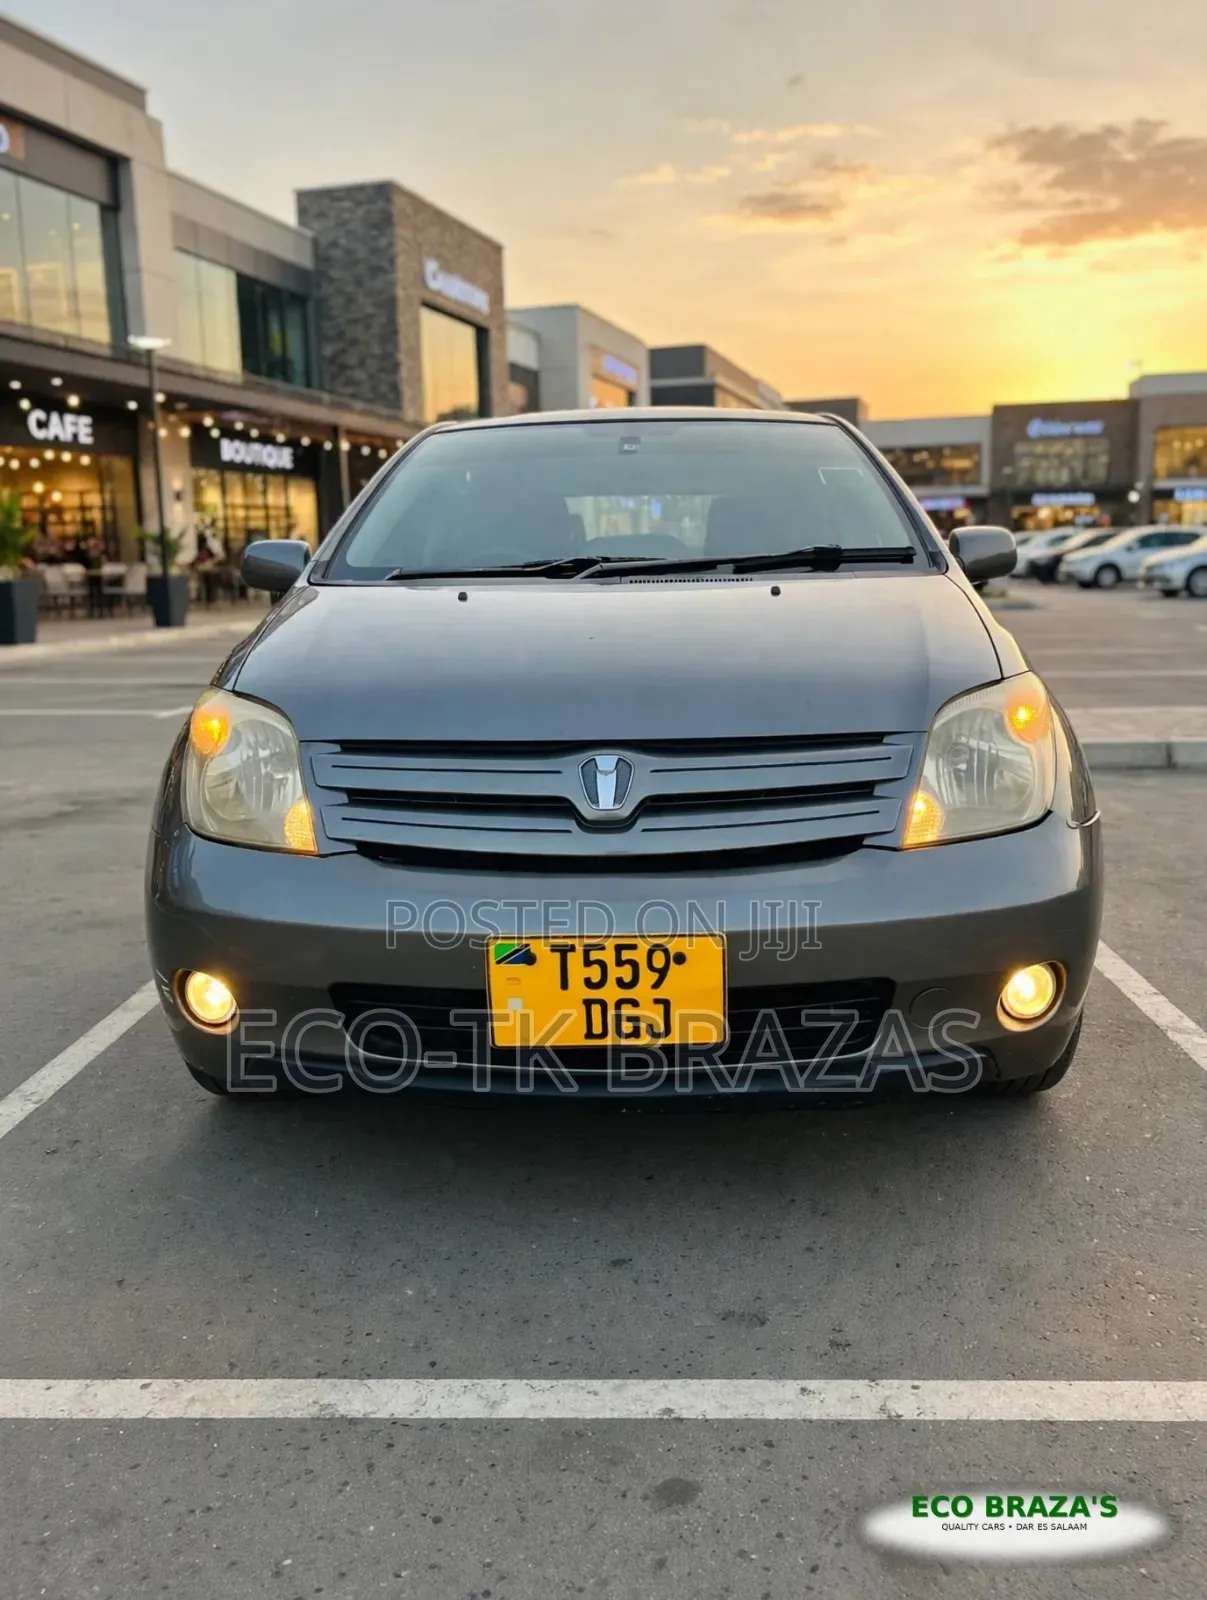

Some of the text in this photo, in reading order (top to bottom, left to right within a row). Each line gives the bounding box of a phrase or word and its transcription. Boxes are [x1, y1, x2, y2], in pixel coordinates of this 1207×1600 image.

[27, 408, 94, 444] CAFE
[219, 437, 294, 470] BOUTIQUE
[550, 943, 672, 991] T559
[582, 997, 673, 1041] DGJ
